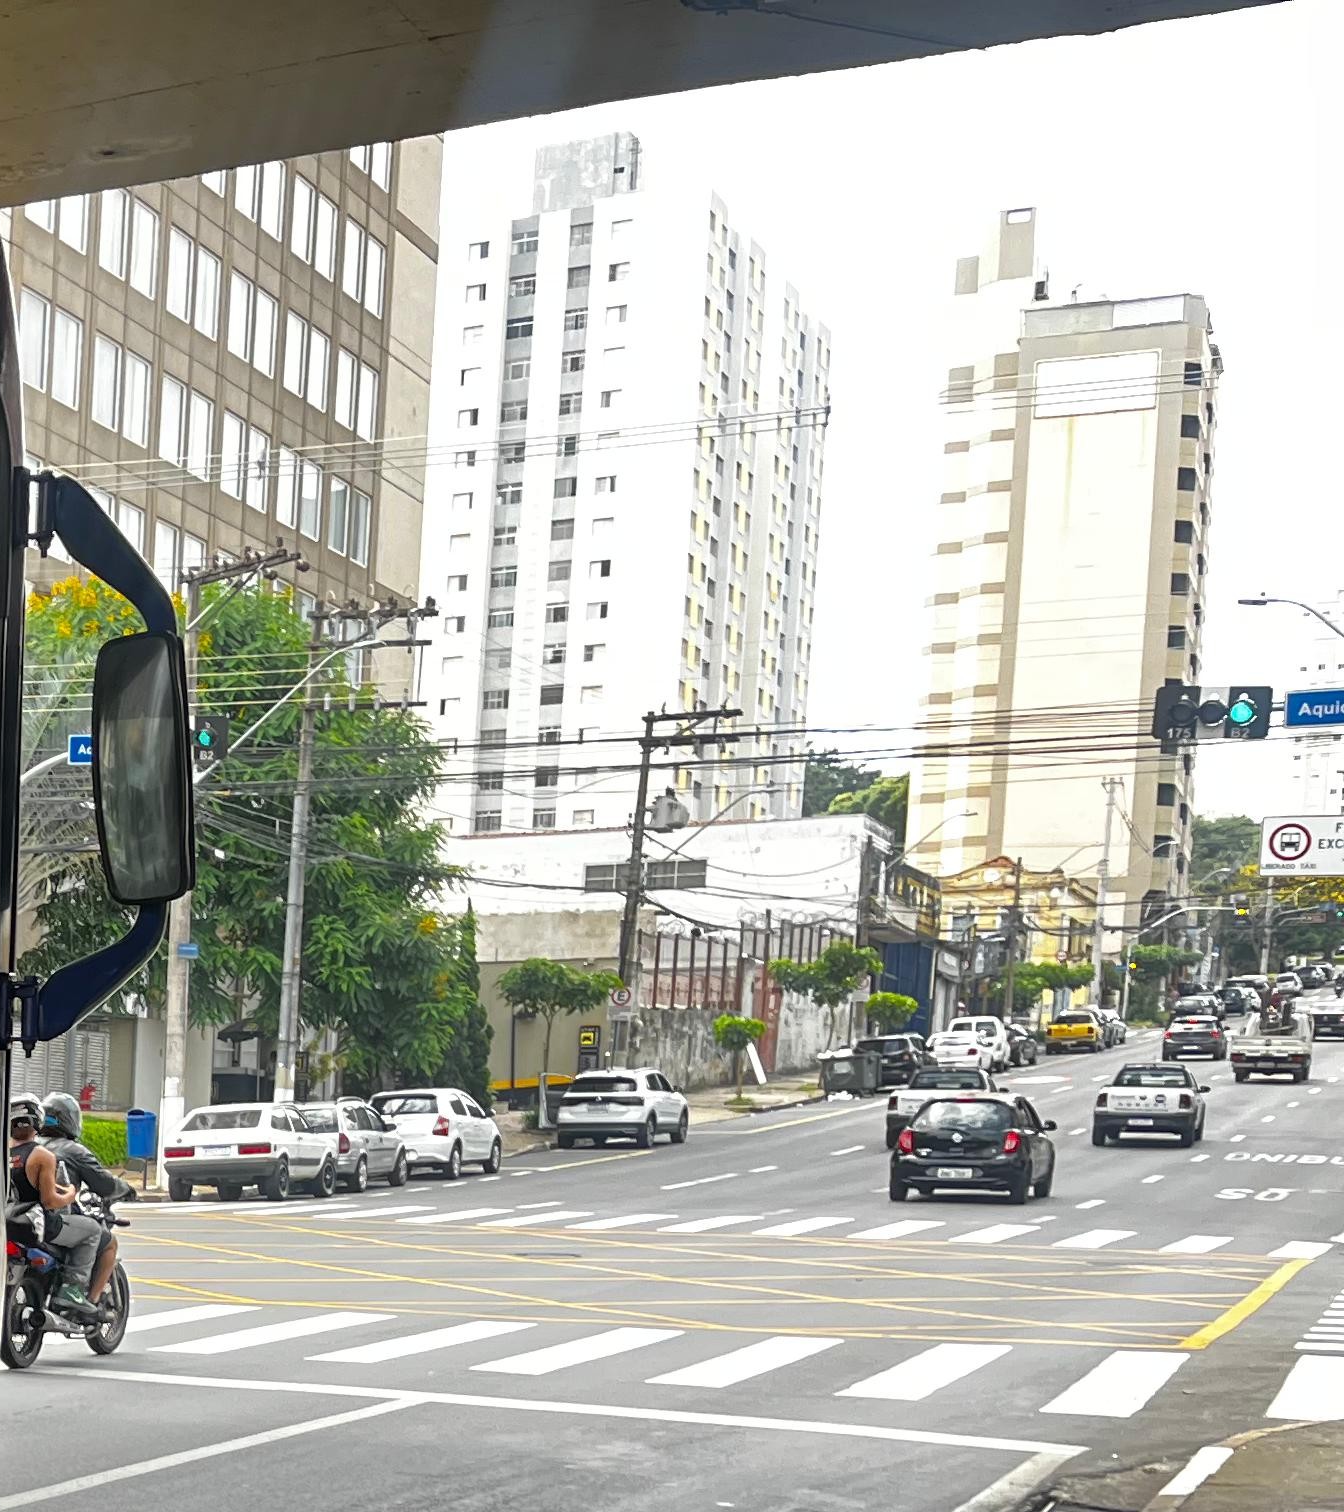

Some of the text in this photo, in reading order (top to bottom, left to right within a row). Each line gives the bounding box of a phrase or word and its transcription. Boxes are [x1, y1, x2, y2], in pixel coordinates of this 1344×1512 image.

[1167, 727, 1192, 739] 175
[1231, 728, 1250, 738] B2
[199, 750, 214, 761] B2
[617, 991, 625, 1002] E
